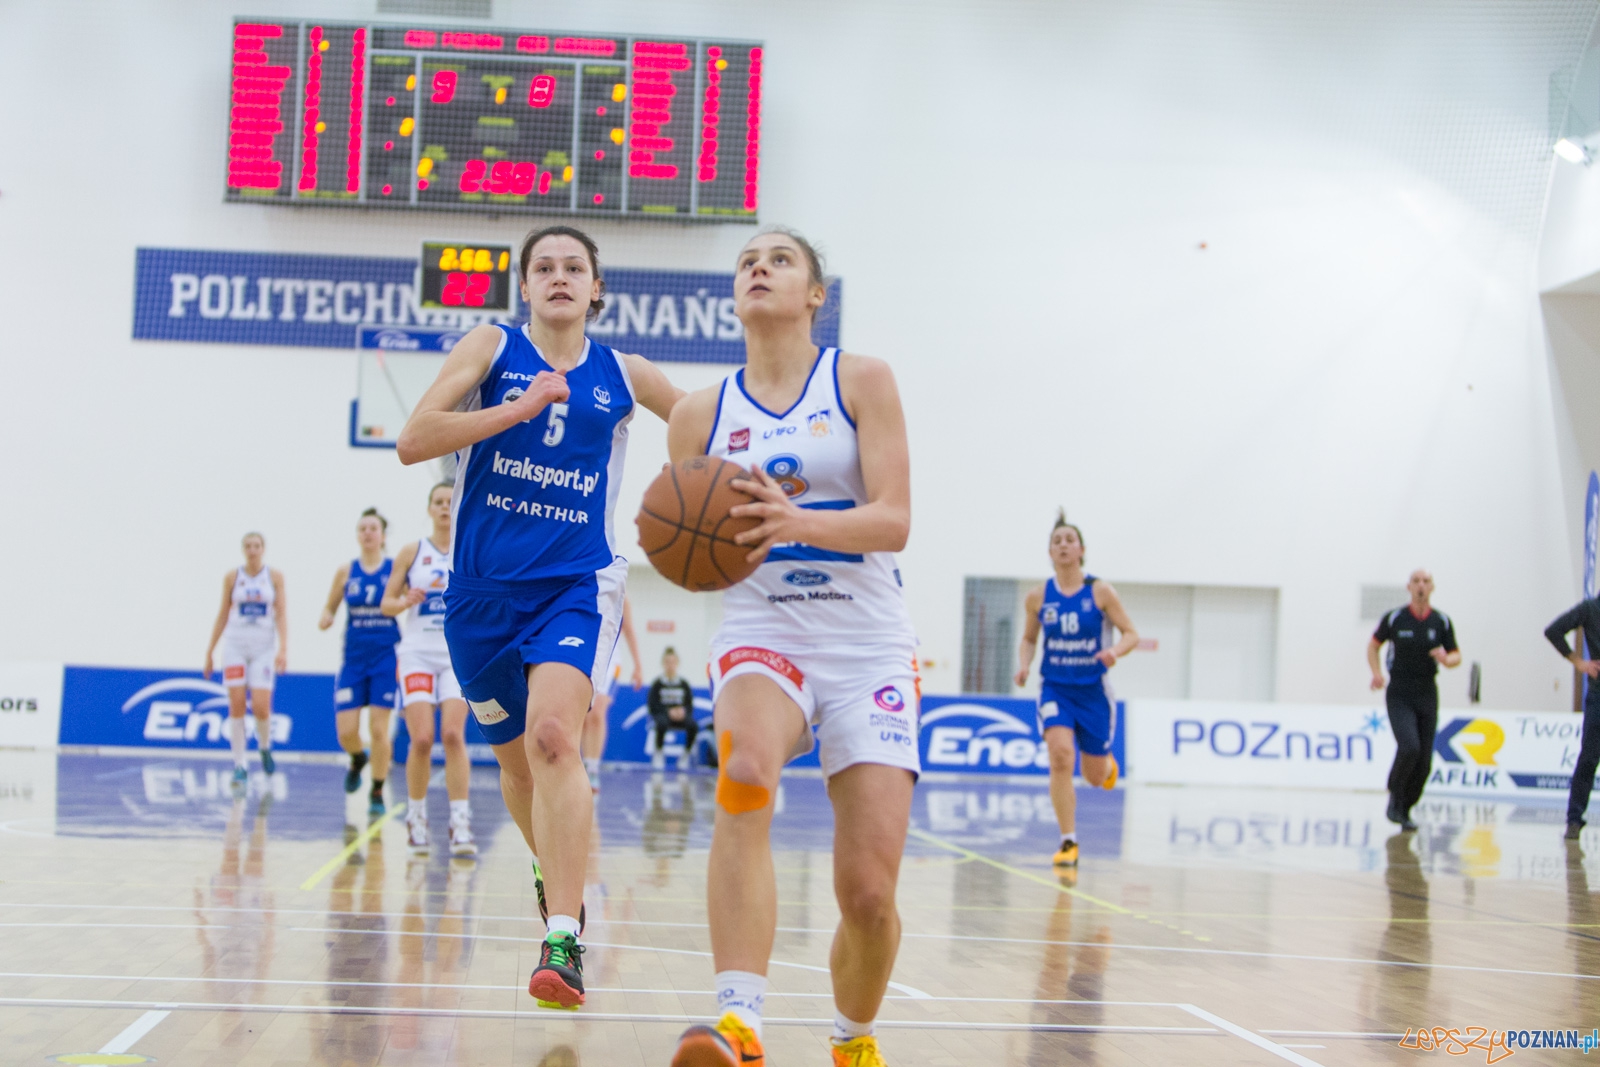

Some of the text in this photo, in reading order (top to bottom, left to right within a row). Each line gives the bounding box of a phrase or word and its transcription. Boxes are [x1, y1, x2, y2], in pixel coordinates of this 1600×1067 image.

[168, 272, 515, 328] POLITECHN
[441, 271, 491, 307] 22
[541, 402, 570, 448] 5
[492, 450, 600, 498] kraksport.pl
[762, 452, 810, 499] 8
